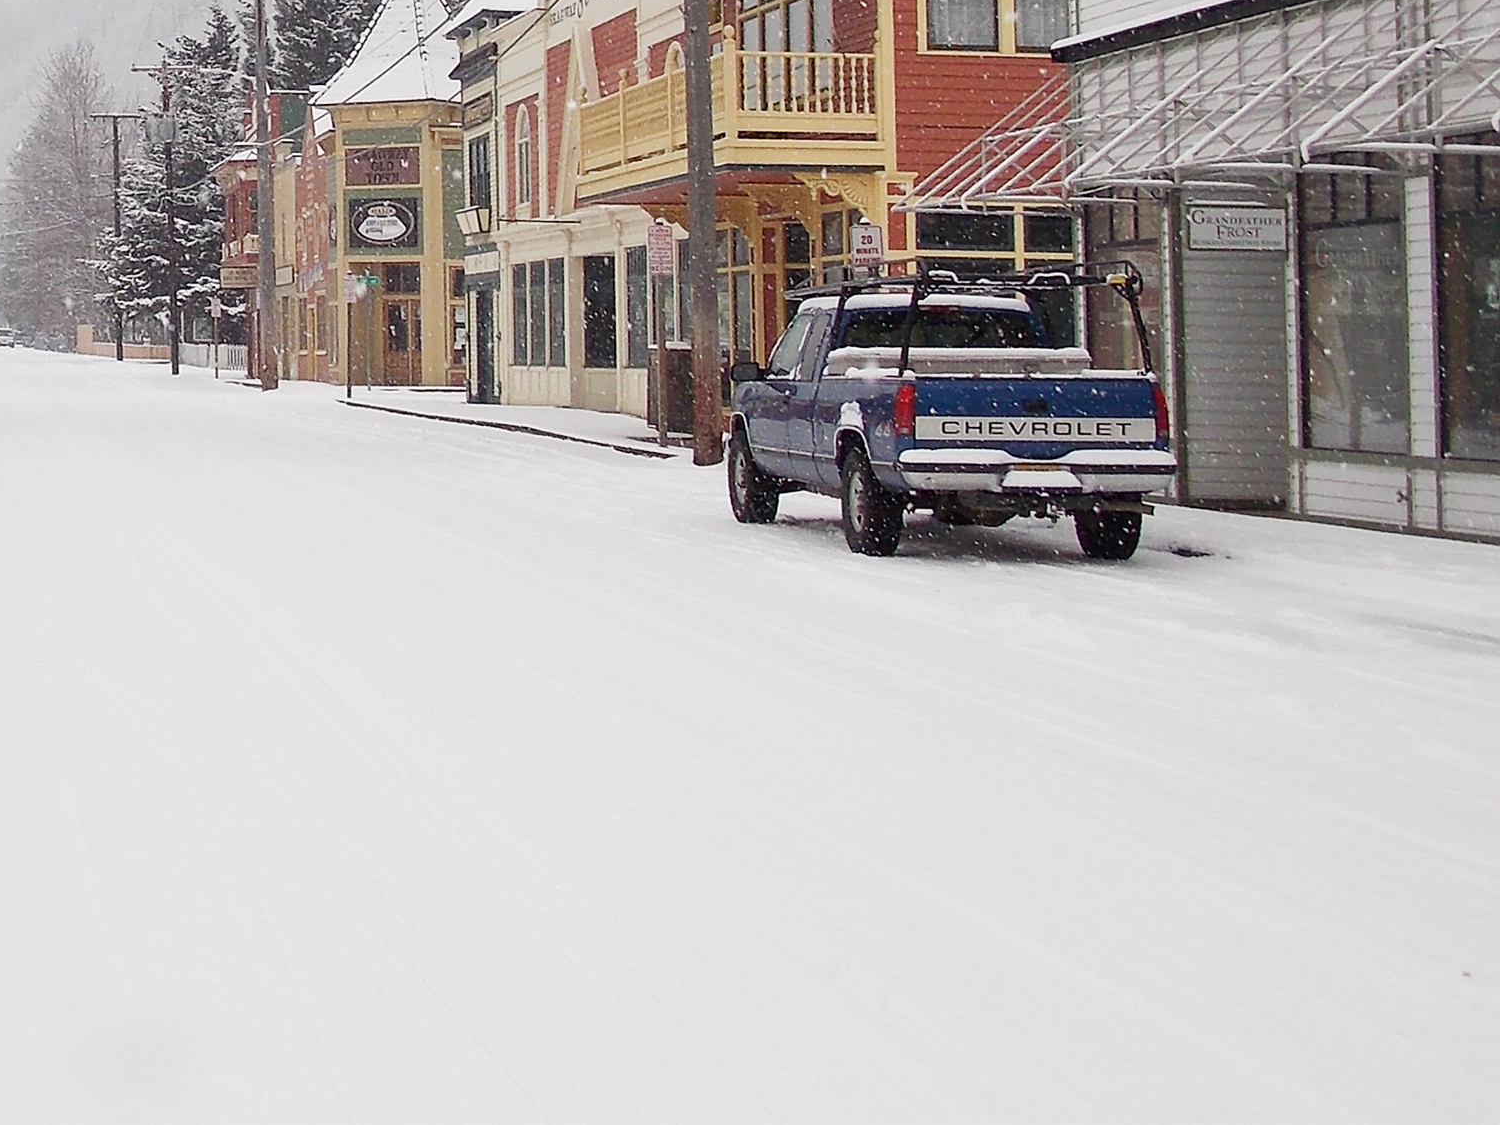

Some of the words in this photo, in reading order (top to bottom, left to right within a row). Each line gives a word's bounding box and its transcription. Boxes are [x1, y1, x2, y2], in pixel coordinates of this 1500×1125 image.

[371, 160, 394, 172] OLD
[1191, 209, 1282, 226] GRANDFATHER
[860, 235, 873, 245] 20
[1215, 225, 1262, 240] FROST
[941, 421, 1133, 437] CHEVROLET
